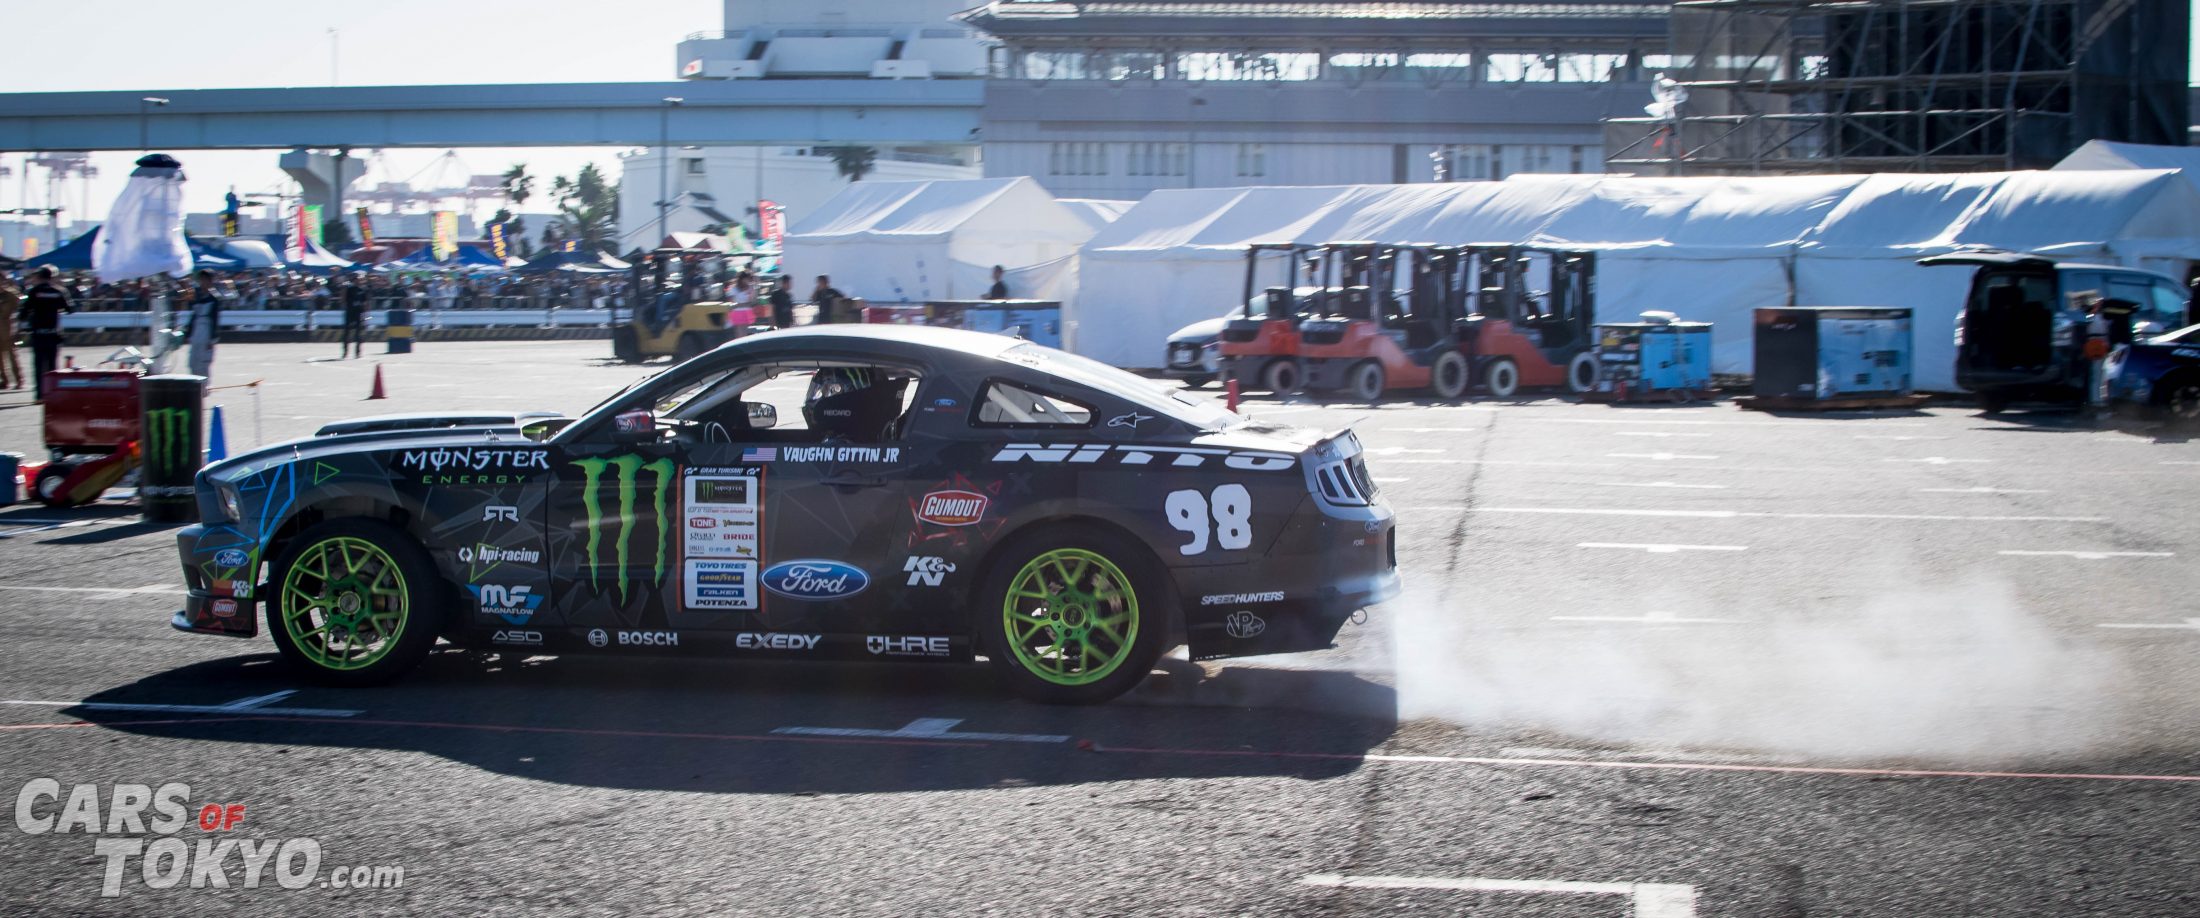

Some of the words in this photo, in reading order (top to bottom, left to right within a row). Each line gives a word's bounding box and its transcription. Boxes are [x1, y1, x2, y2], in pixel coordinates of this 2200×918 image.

[402, 447, 550, 471] MONSTER
[783, 446, 835, 463] VAUGHN
[837, 447, 881, 463] GITTIN
[883, 447, 900, 463] JR
[992, 443, 1295, 471] NITTO
[422, 475, 526, 484] ENERGY
[924, 496, 982, 517] GUMOUT
[691, 519, 714, 527] TONE
[1164, 483, 1252, 555] 98
[723, 533, 755, 541] BRIDE
[220, 552, 243, 566] Ford
[781, 565, 848, 594] Ford
[695, 599, 747, 607] POTENZA
[1200, 590, 1284, 606] SPEEDHUNTERS
[481, 607, 534, 615] MAGNAFLOW
[492, 630, 543, 642] ASD
[618, 631, 679, 646] BOSCH
[735, 632, 823, 650] EXEDY
[885, 636, 950, 653] HRE
